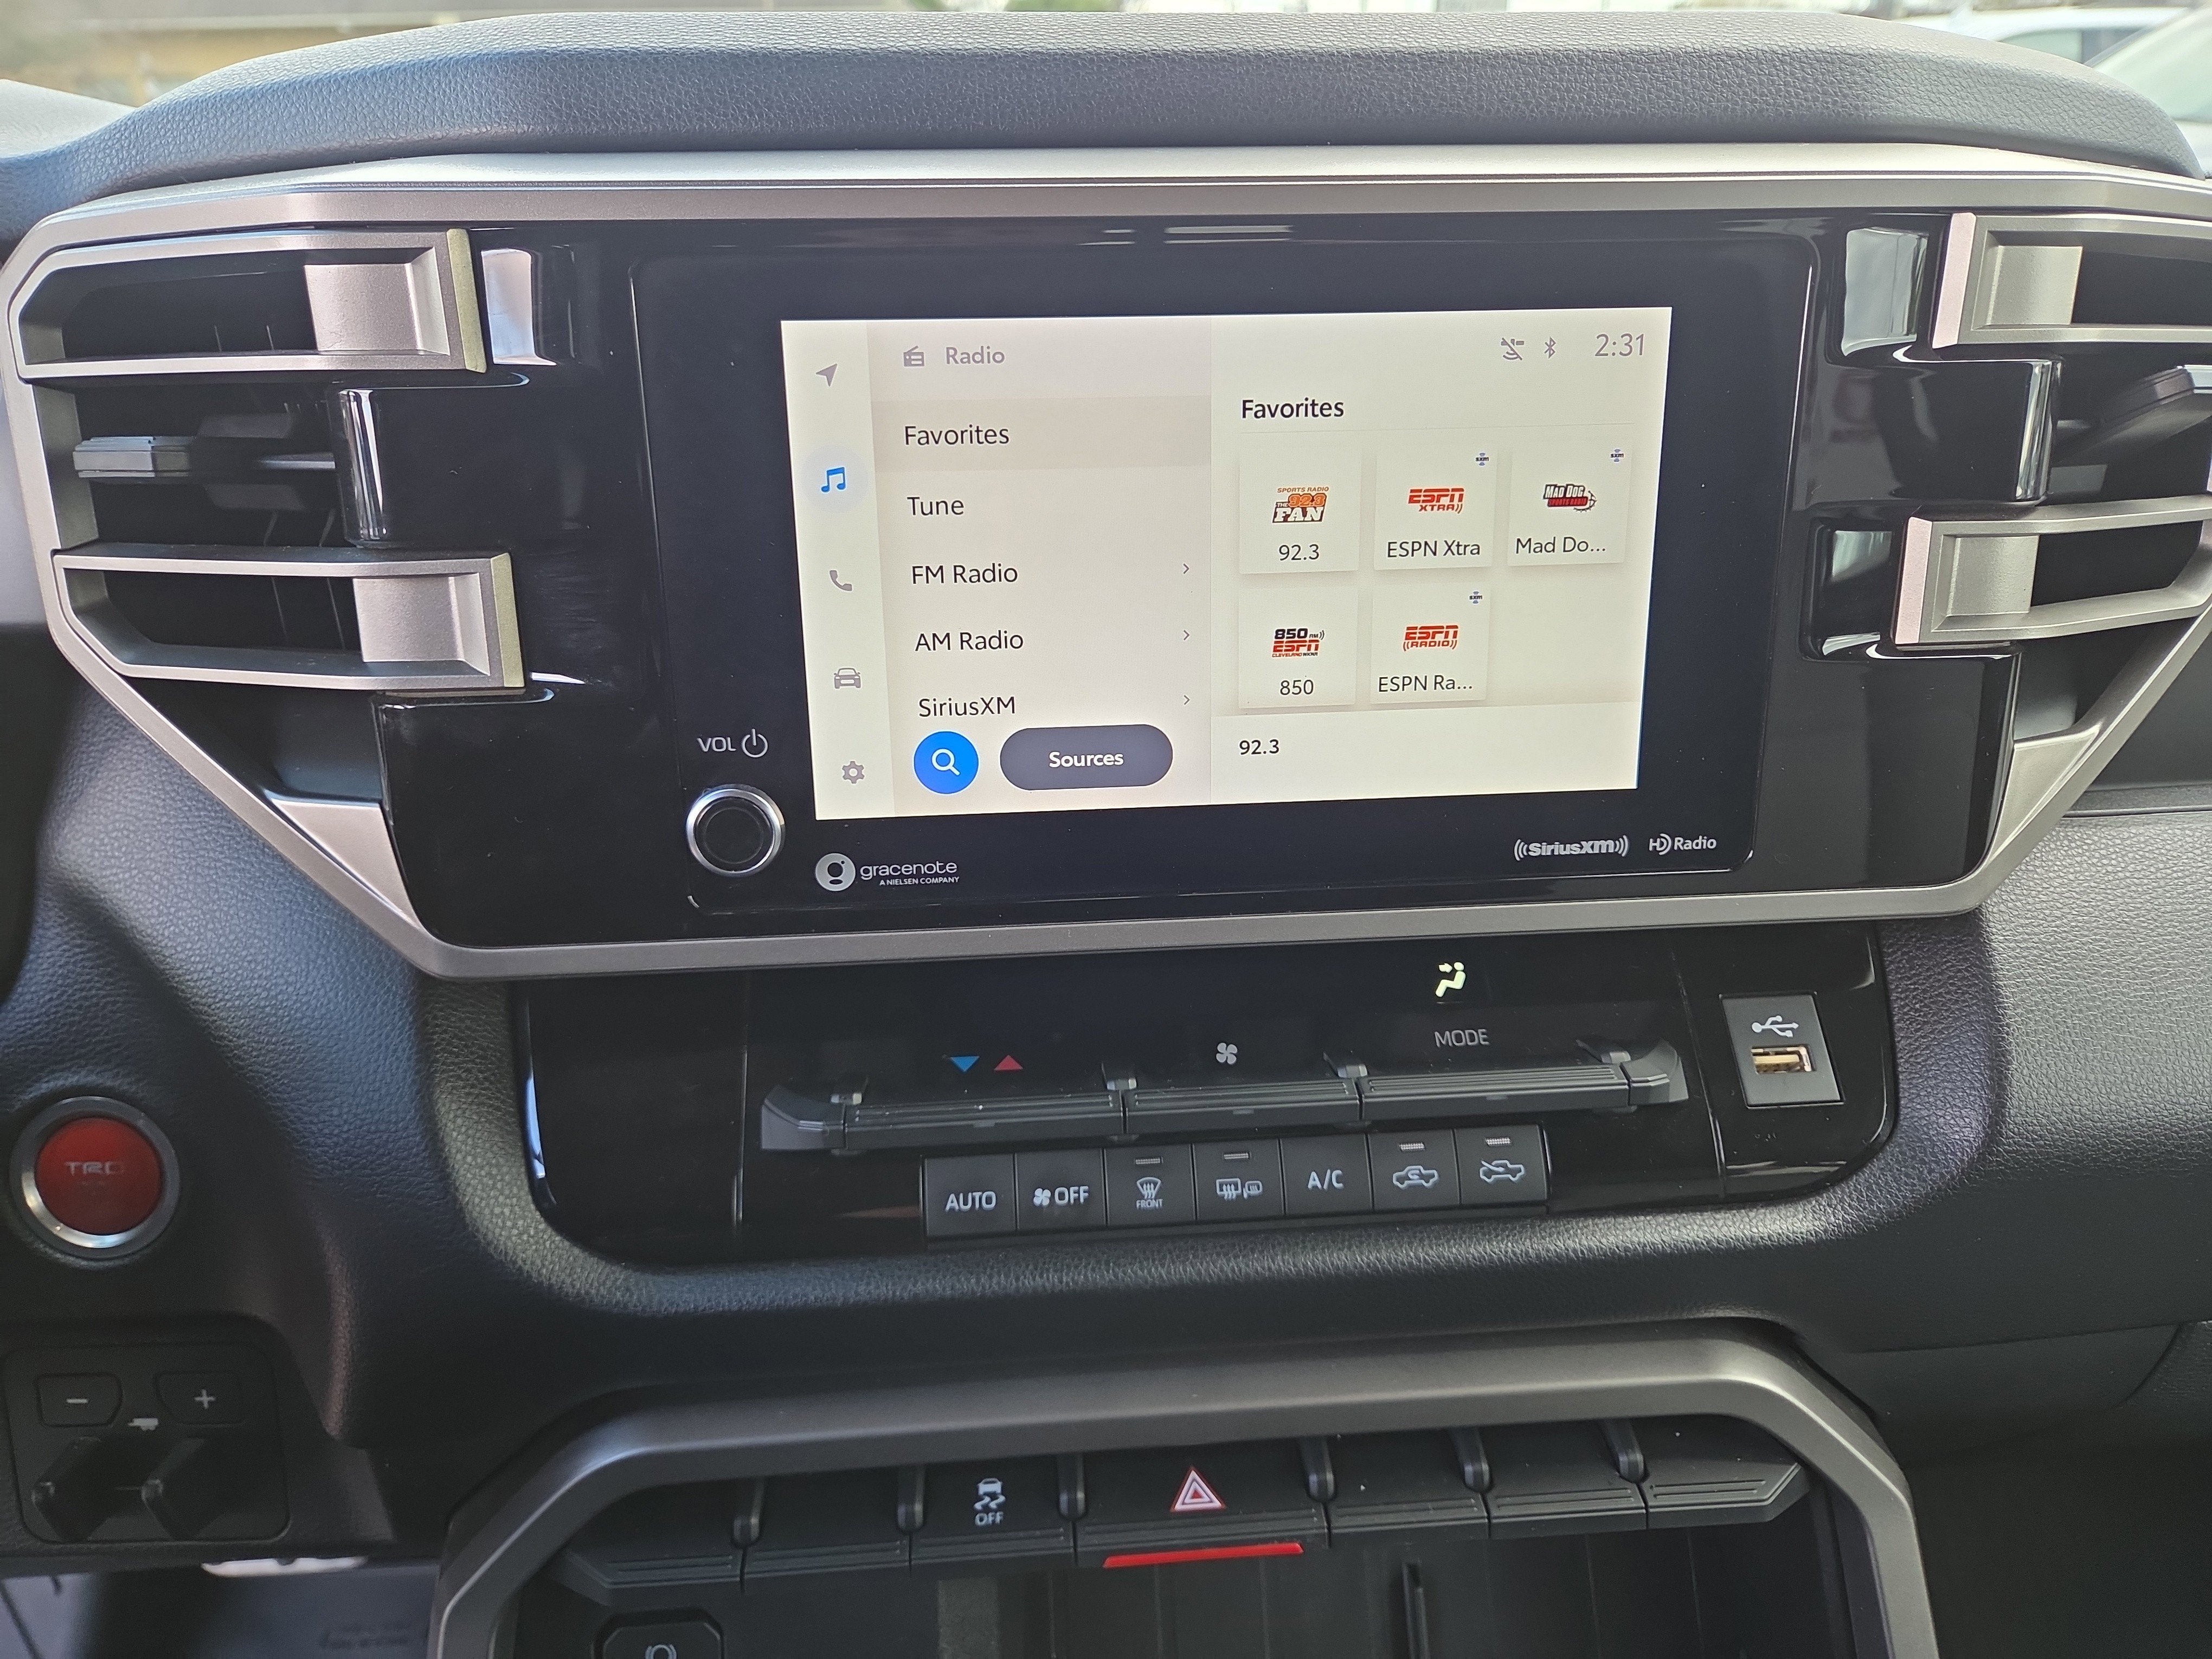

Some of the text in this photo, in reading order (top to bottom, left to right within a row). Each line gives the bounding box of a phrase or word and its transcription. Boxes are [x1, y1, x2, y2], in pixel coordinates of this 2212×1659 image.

[1594, 333, 1644, 357] 2:31
[946, 345, 1005, 365] Radio
[1242, 397, 1344, 419] Favorites
[905, 424, 1009, 446] Favorites
[1289, 493, 1326, 507] 92.3
[1409, 488, 1464, 504] ESPN
[1545, 485, 1585, 498] MAD DOG
[907, 497, 964, 516] Tune
[1274, 506, 1323, 522] FAN
[1278, 544, 1320, 561] 92.3
[1387, 539, 1480, 558] ESPN Xtra
[1516, 536, 1556, 554] Mad
[912, 562, 1018, 584] FM Radio
[915, 629, 1024, 652] AM Radio
[1275, 628, 1308, 639] 850
[1405, 625, 1458, 640] ESPN
[1273, 640, 1320, 652] ESPN
[1279, 679, 1314, 696] 850
[1379, 675, 1427, 692] ESPN
[919, 696, 1015, 717] SiriusXM
[697, 737, 736, 752] VOL
[1239, 739, 1279, 755] 92.3
[1049, 751, 1124, 768] Sources
[1674, 835, 1717, 850] Radio
[860, 860, 957, 880] gracenote
[919, 876, 960, 884] COMPANY
[1434, 1028, 1489, 1047] MODE
[1308, 1169, 1343, 1189] A/C
[945, 1191, 996, 1211] AUTO
[1054, 1186, 1089, 1205] OFF
[1136, 1197, 1162, 1208] FRONT
[974, 1511, 1005, 1527] OFF
